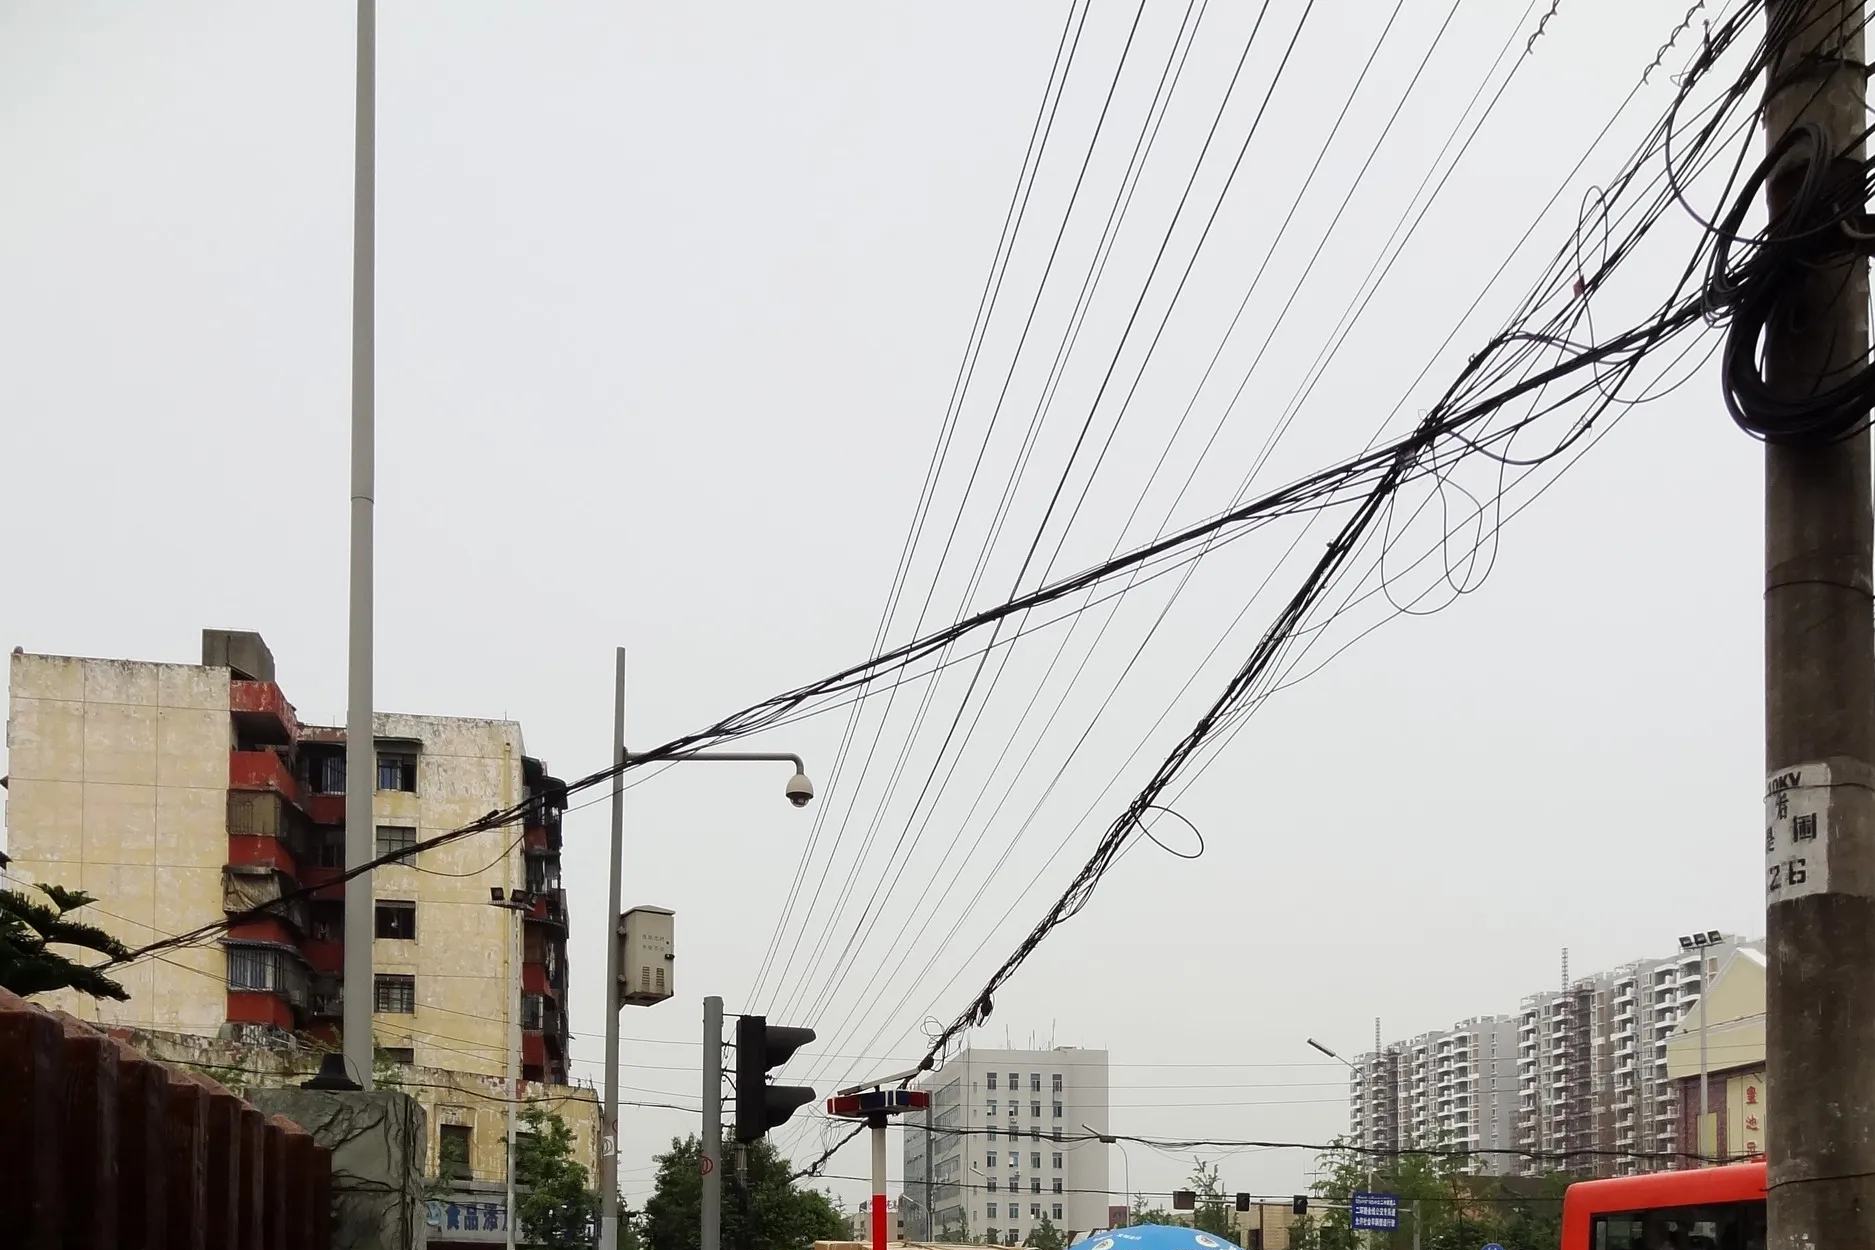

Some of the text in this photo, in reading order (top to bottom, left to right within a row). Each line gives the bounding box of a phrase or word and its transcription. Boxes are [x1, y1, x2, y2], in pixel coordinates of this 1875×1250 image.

[1768, 858, 1807, 892] 26
[445, 1203, 508, 1232] 食品添
